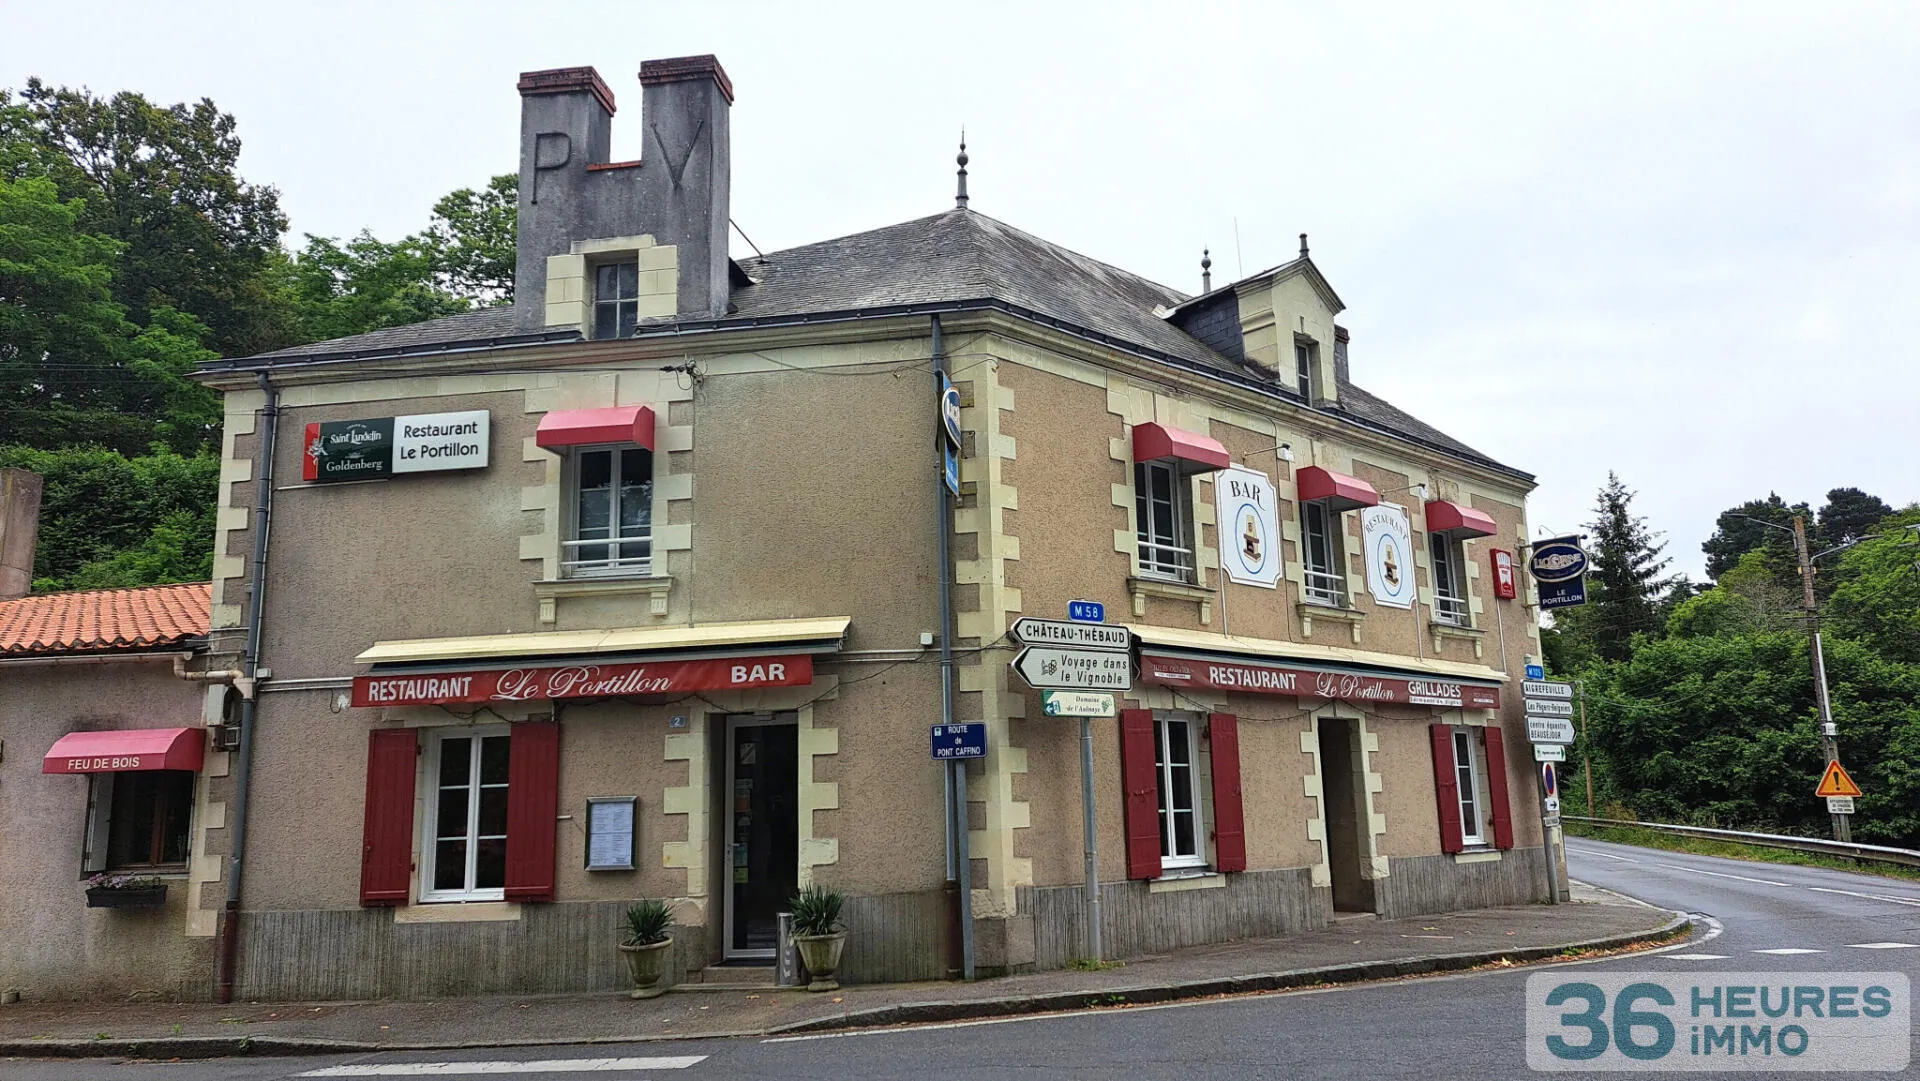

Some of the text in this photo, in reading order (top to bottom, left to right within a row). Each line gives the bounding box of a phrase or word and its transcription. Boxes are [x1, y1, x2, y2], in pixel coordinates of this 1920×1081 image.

[404, 421, 478, 438] Restaurant
[329, 430, 382, 445] Saint Landelin
[400, 442, 479, 460] Le Portillon
[326, 459, 384, 472] Goldenberg
[1230, 480, 1266, 512] BAR
[1365, 513, 1409, 541] RESTAURANT
[1542, 595, 1583, 605] PORTILLON
[1074, 605, 1099, 618] M 58
[1025, 623, 1126, 643] CHÂTEAU-THÉBAUD
[1060, 654, 1127, 670] Voyage dans
[368, 663, 786, 702] RESTAURANT Le Portillon BAR
[1060, 670, 1123, 686] le Vignoble
[1209, 666, 1461, 700] RESTAURANT Le Portillon GRILLADES
[1525, 684, 1565, 695] AIGREFEUILLE
[674, 717, 681, 726] 2
[948, 725, 968, 734] ROUTE
[954, 737, 962, 745] de
[937, 746, 981, 757] PONT CAFFINO
[68, 756, 140, 770] FEU DE BOIS
